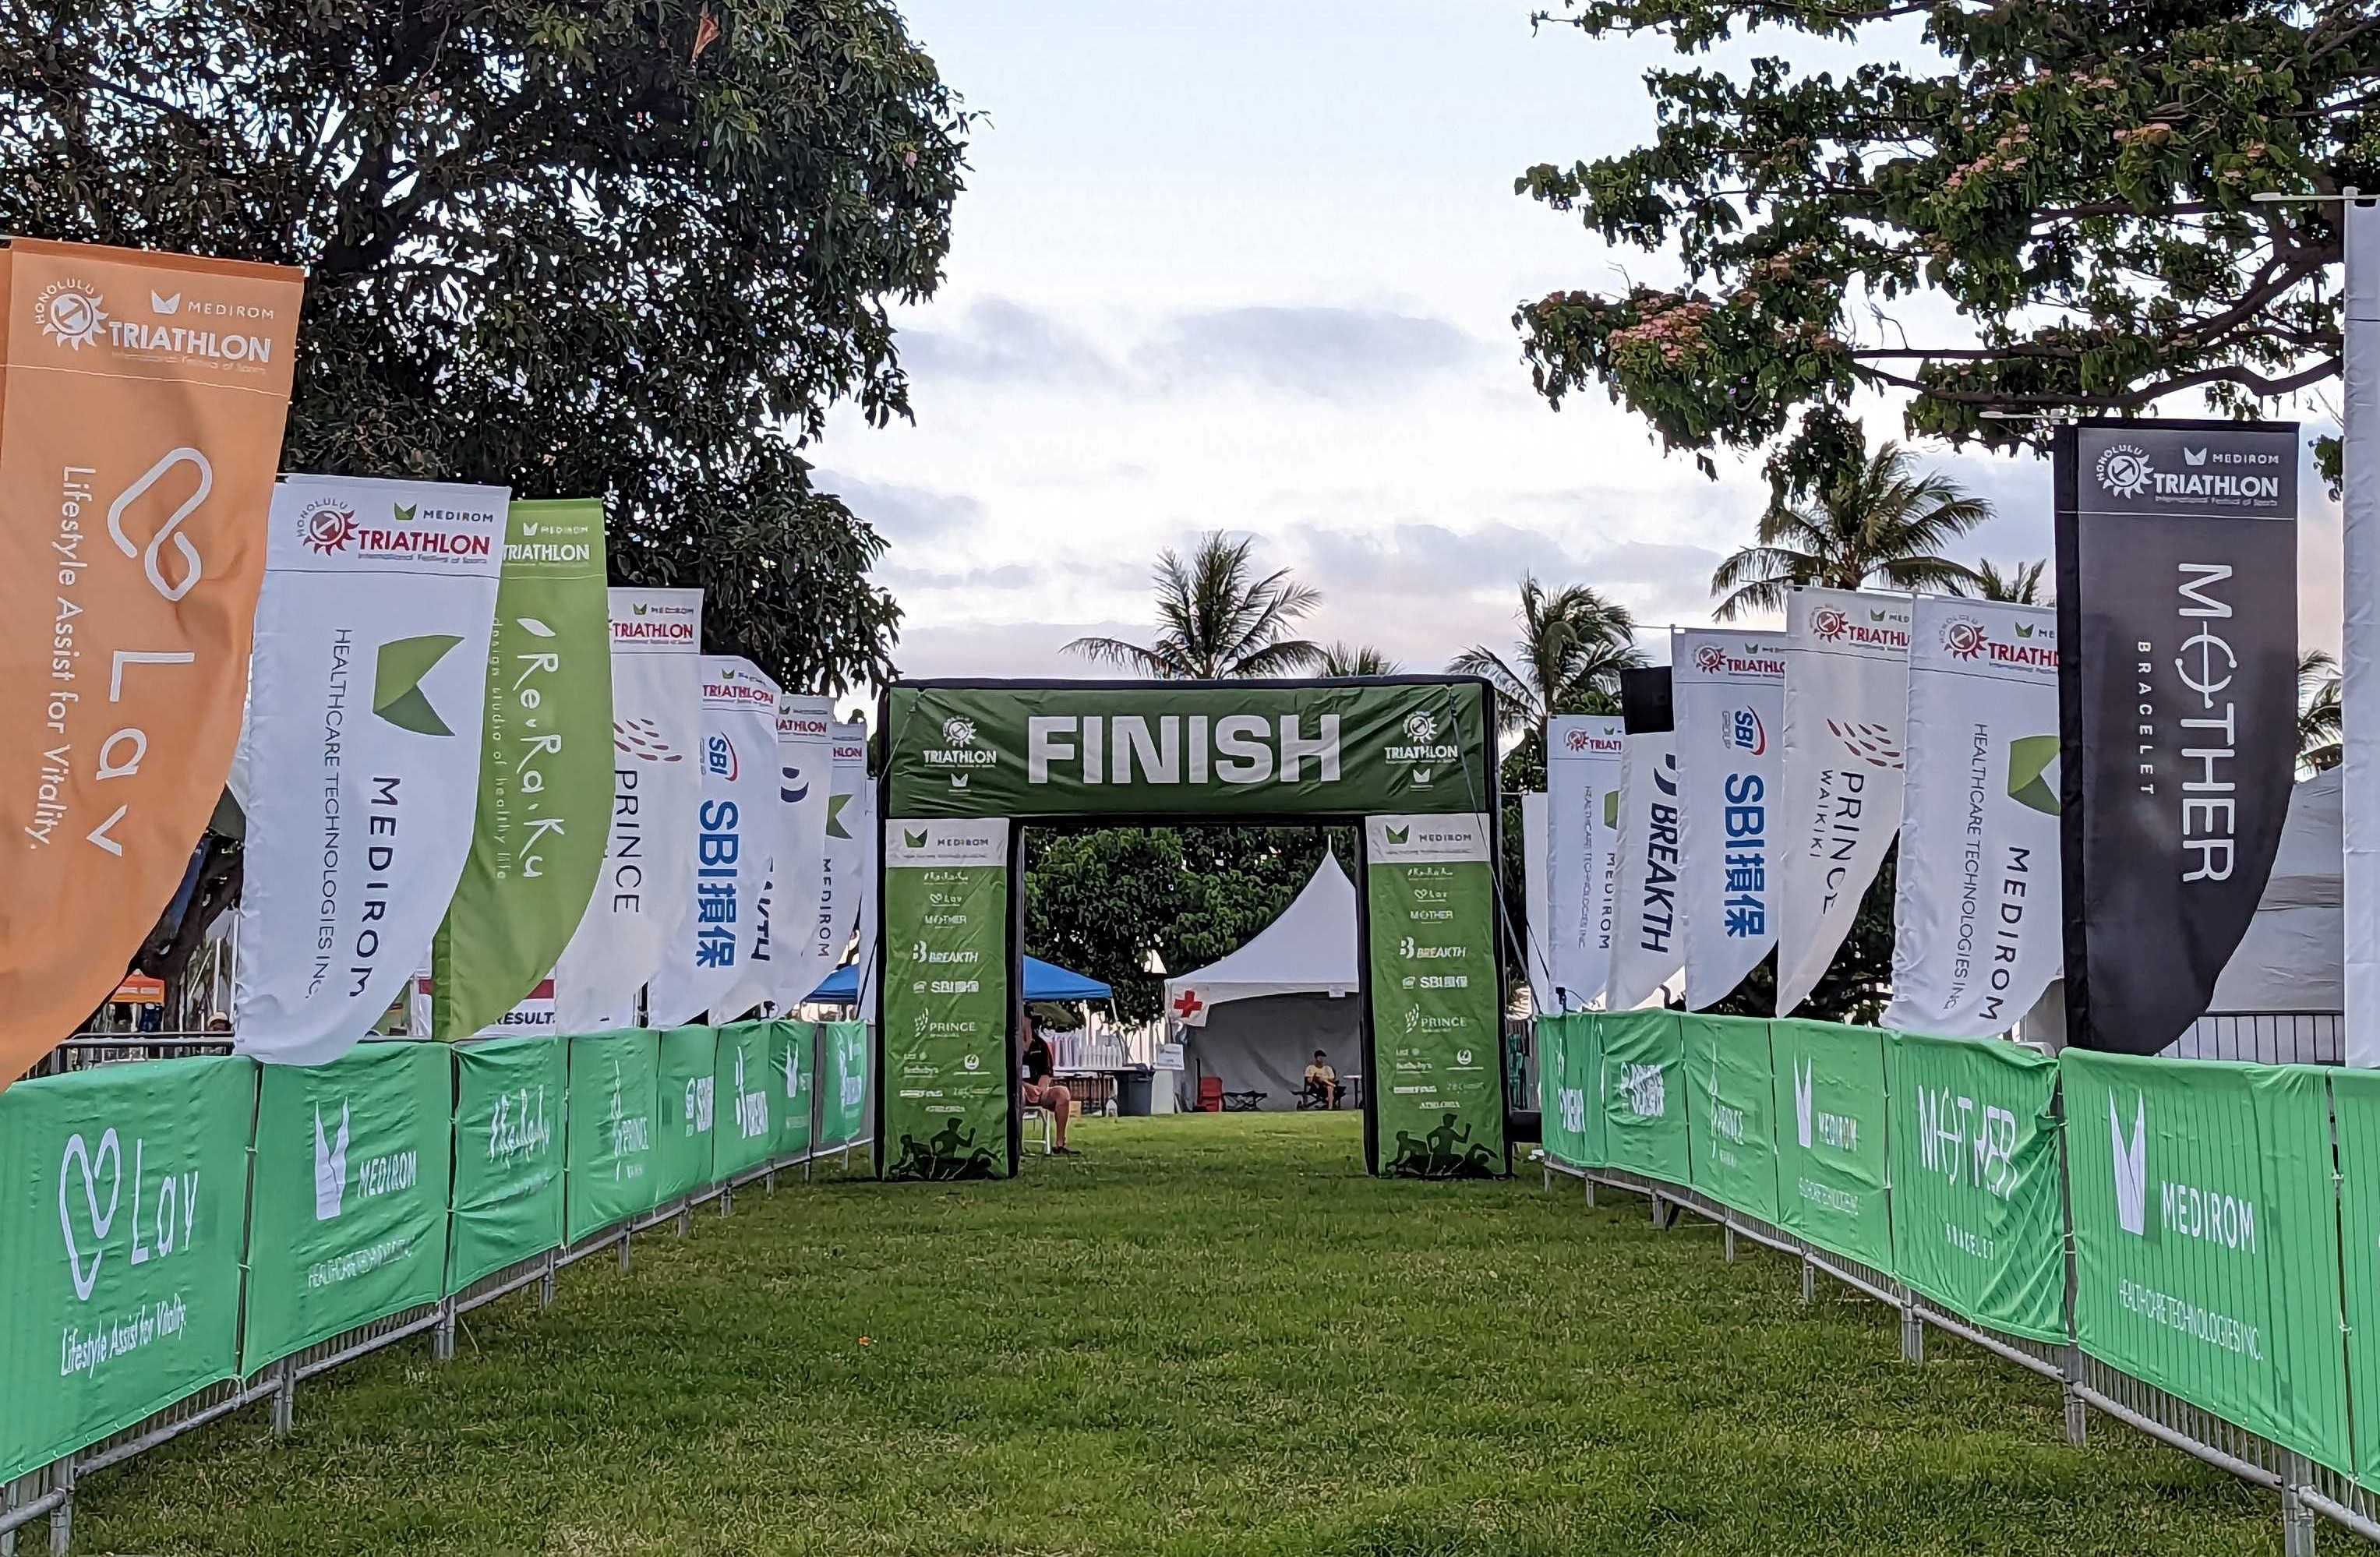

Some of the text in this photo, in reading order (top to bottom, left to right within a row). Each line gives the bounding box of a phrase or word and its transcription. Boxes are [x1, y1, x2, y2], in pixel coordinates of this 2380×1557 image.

[34, 277, 94, 325] HONOLULU
[187, 300, 275, 320] MEDIROM
[108, 320, 271, 363] TRIATHLON
[2096, 444, 2143, 482] HONOLULU
[2212, 453, 2279, 464] MEDIROM
[2153, 472, 2279, 497] TRIATHLON
[422, 510, 494, 523] MEDIROM
[358, 529, 491, 556] TRIATHLON
[613, 623, 694, 639] TRIATHLON
[1848, 625, 1910, 647] TRIATHL
[24, 466, 96, 851] Lifestyle Assist for Vitality.
[323, 627, 353, 768] HEALTHCARE
[702, 684, 774, 704] TRIATHLON
[2136, 641, 2154, 796] BRACELET
[1734, 710, 1754, 750] SBI
[2174, 562, 2238, 883] MOTHER
[708, 736, 729, 775] SBI
[923, 750, 997, 764] TRIATHLON
[1027, 712, 1342, 785] FINISH
[1384, 745, 1458, 760] TRIATHLON
[1967, 723, 1988, 835] HEALTHCARE
[1810, 769, 1834, 857] WAIKIKI
[317, 771, 341, 952] TECHNOLOGIES
[613, 769, 642, 914] PRINCE
[1418, 834, 1472, 842] MEDIROM
[1723, 772, 1766, 938] SBI損保
[1823, 771, 1865, 915] PRINCE
[348, 776, 402, 998] MEDIROM
[694, 799, 740, 969] SBI損保
[1640, 802, 1679, 953] BREAKTH
[1410, 910, 1453, 920] MOTHER
[1954, 840, 1981, 979] TECHNOLOGIES
[1979, 846, 2030, 1021] MEDIROM
[928, 952, 979, 963] BREAKTH
[496, 1012, 556, 1026] ESULT
[929, 1022, 976, 1032] PRINCE
[1421, 1017, 1467, 1027] PRINCE
[1918, 1084, 2018, 1202] MOTHER
[358, 1149, 417, 1199] MEDIROM
[2161, 1179, 2256, 1255] MEDIROM
[61, 1319, 108, 1380] Lifestyle
[109, 1312, 141, 1359] Assist
[2166, 1295, 2240, 1353] TECHNOLOGIES
